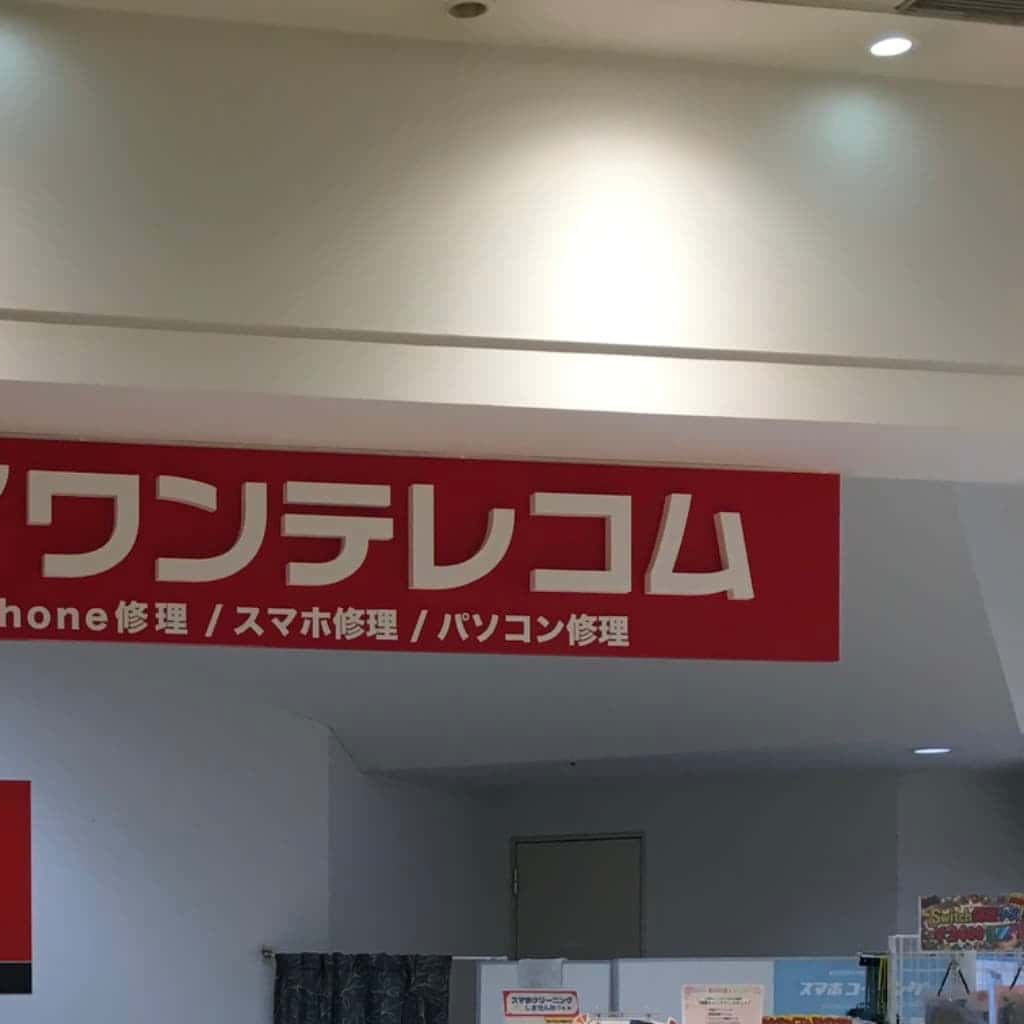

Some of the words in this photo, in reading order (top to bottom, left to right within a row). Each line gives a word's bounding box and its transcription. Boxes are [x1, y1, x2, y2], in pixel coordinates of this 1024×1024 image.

[233, 606, 399, 641] スマホ修理
[437, 613, 630, 648] パソコン修理
